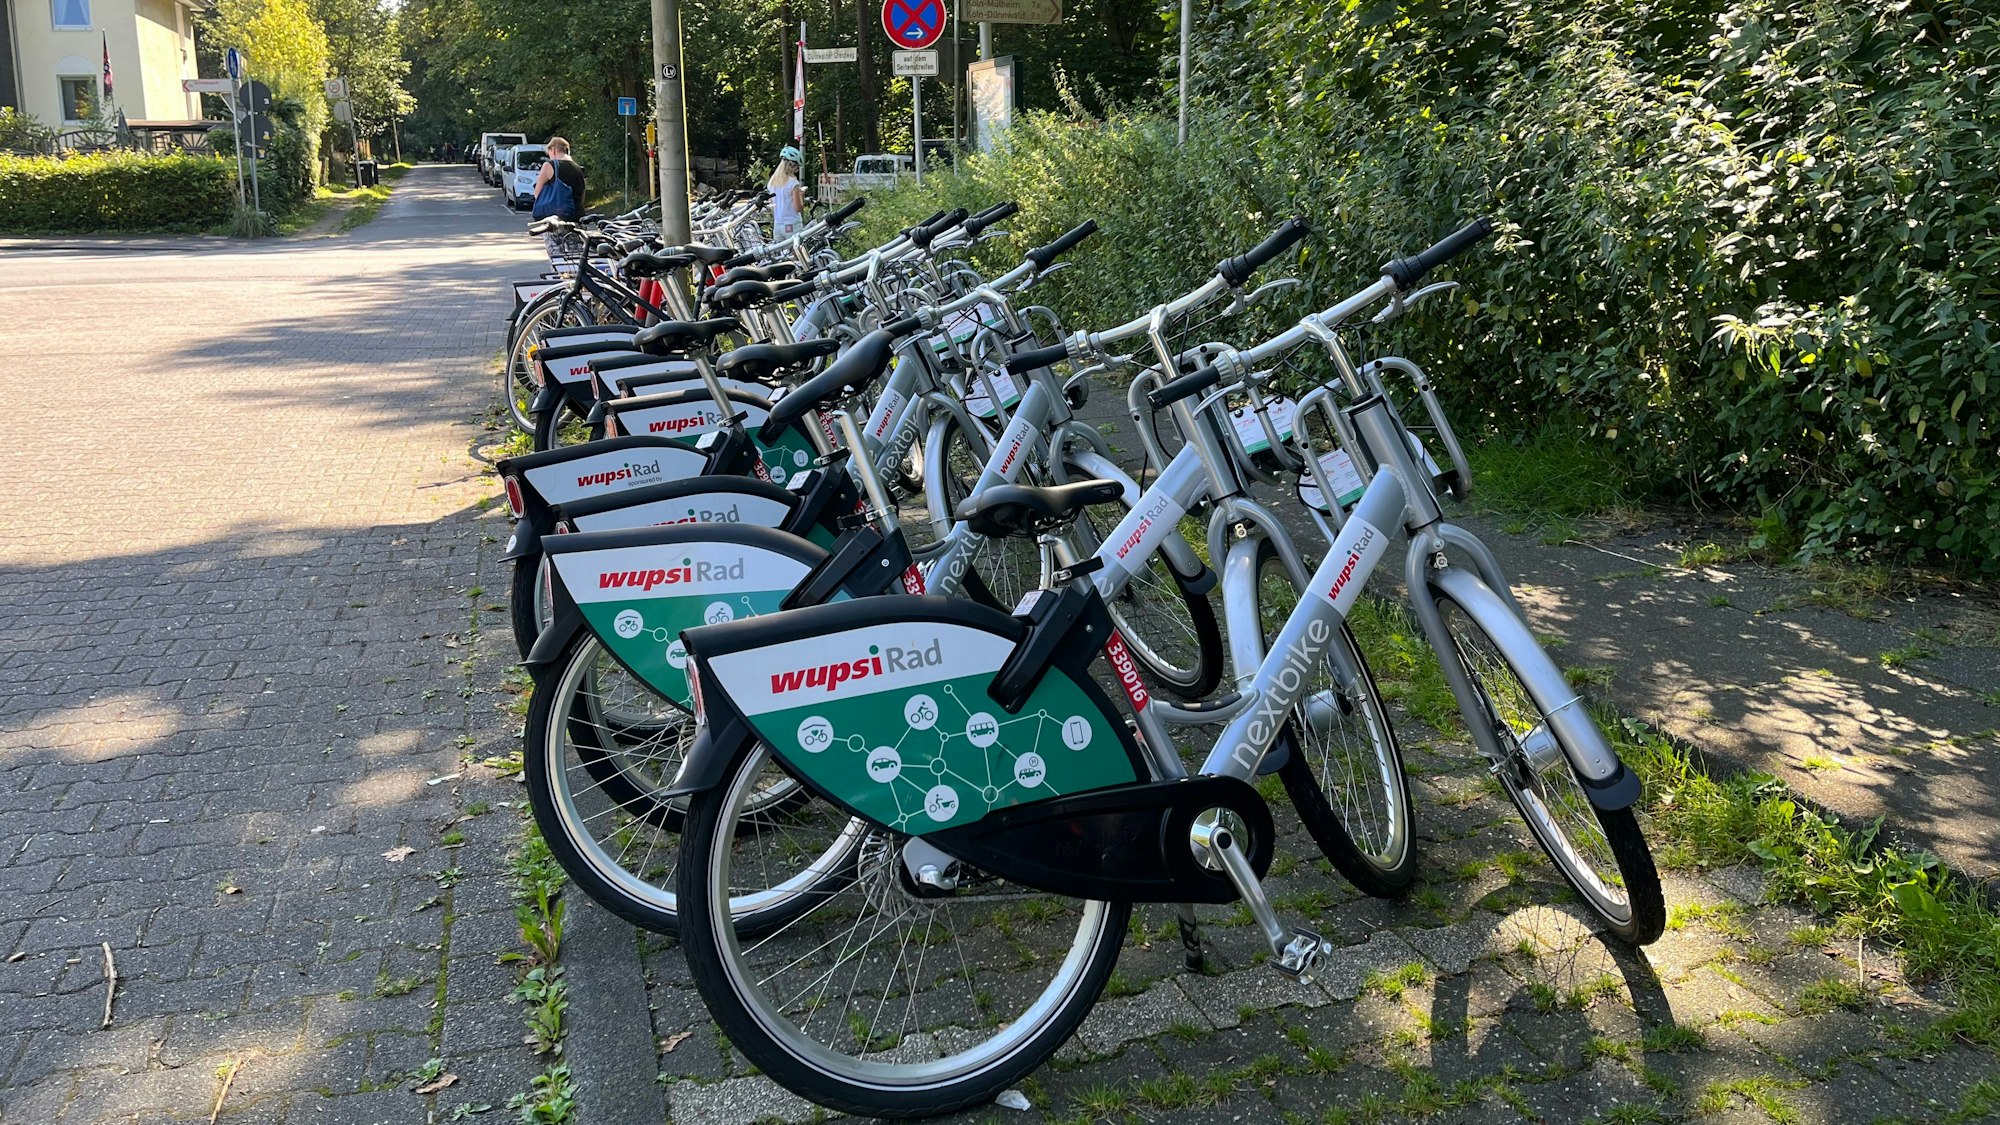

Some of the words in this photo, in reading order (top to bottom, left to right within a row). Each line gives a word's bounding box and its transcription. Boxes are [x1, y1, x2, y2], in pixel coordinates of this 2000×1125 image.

[649, 410, 705, 433] wupsi
[707, 410, 725, 424] Ra
[876, 407, 893, 438] wupsi
[889, 393, 900, 410] Rad
[577, 463, 632, 487] wupsi
[632, 460, 661, 477] Rad
[879, 414, 920, 481] nextbik
[1000, 439, 1021, 475] wupsi
[1016, 423, 1031, 440] Rad
[1116, 516, 1152, 559] wupsi
[1147, 496, 1169, 522] Rad
[599, 558, 692, 591] wupsi
[696, 558, 745, 582] Rad
[1327, 550, 1360, 601] wupsi
[1353, 527, 1375, 555] Rad
[770, 645, 884, 694] wupsi
[886, 638, 944, 674] Rad
[1107, 641, 1147, 703] 339016
[1231, 618, 1330, 771] nextbike
